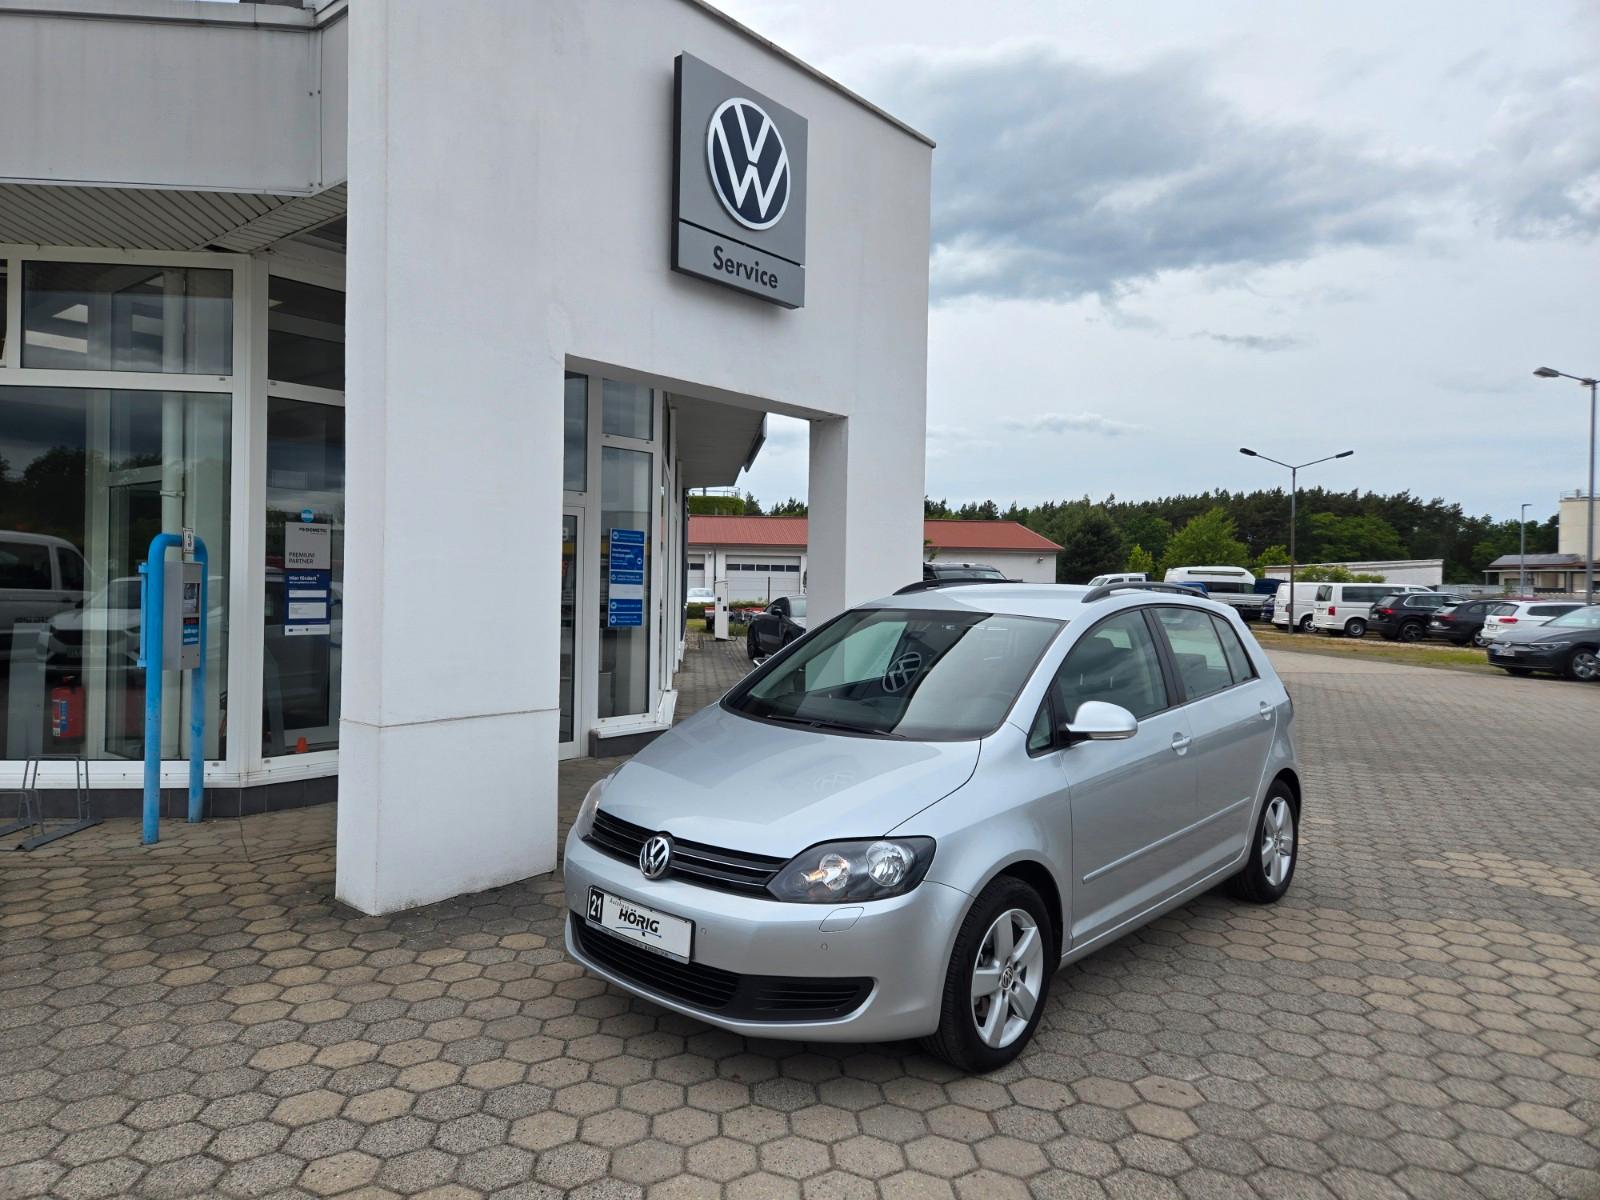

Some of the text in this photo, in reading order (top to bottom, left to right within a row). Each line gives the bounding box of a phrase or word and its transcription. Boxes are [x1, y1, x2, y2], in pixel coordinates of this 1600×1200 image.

[713, 245, 778, 289] Service
[590, 894, 602, 918] 21
[618, 909, 660, 935] HÖRIG
